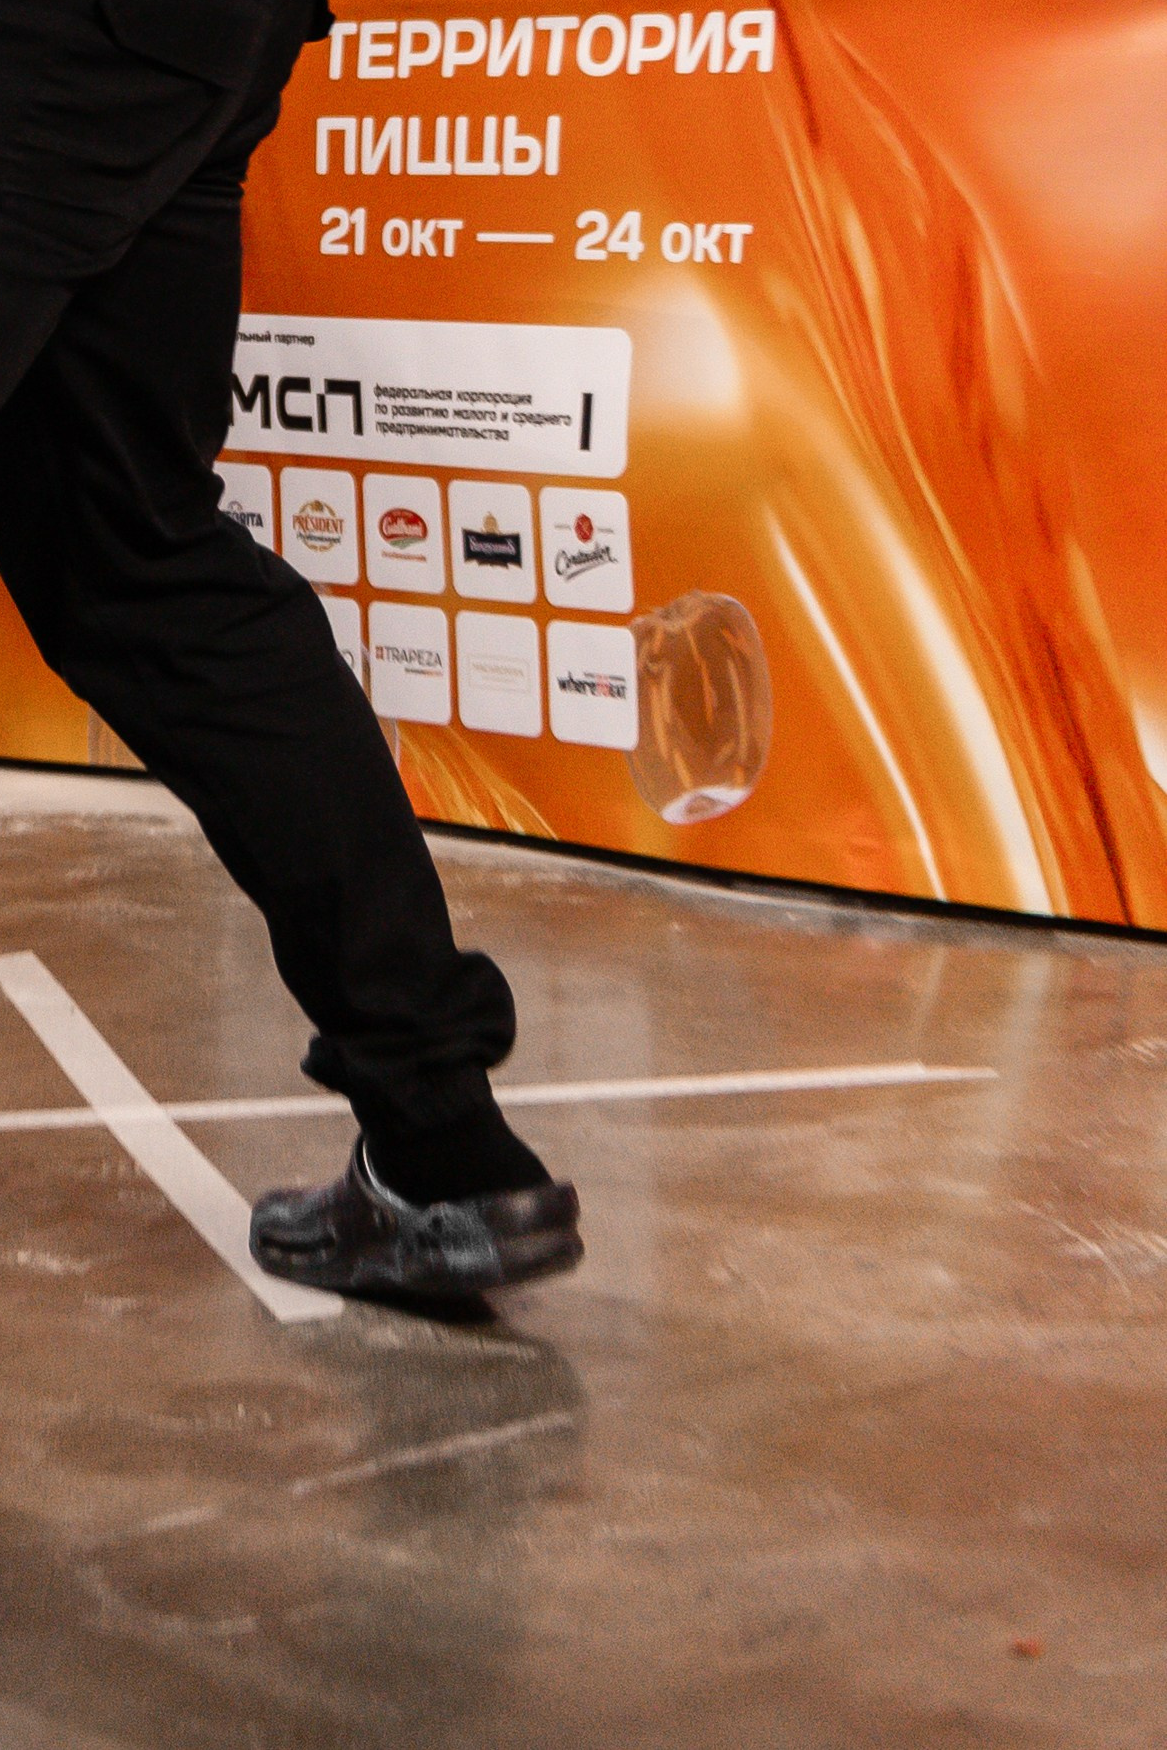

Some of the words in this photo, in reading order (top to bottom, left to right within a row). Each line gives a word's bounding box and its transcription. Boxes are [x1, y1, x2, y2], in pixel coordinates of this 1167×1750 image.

[329, 10, 776, 81] ТЕРРИТОРИЯ
[315, 115, 562, 177] ПИЦЦЫ
[320, 207, 367, 257] 21
[381, 218, 464, 258] окт
[575, 209, 644, 262] 24
[661, 222, 753, 264] окт
[373, 382, 453, 401] федеральная
[456, 390, 533, 408] корпорация
[374, 403, 388, 416] по
[391, 405, 450, 421] развитию
[453, 408, 498, 422] малого
[501, 412, 509, 422] и
[512, 411, 572, 428] среднего
